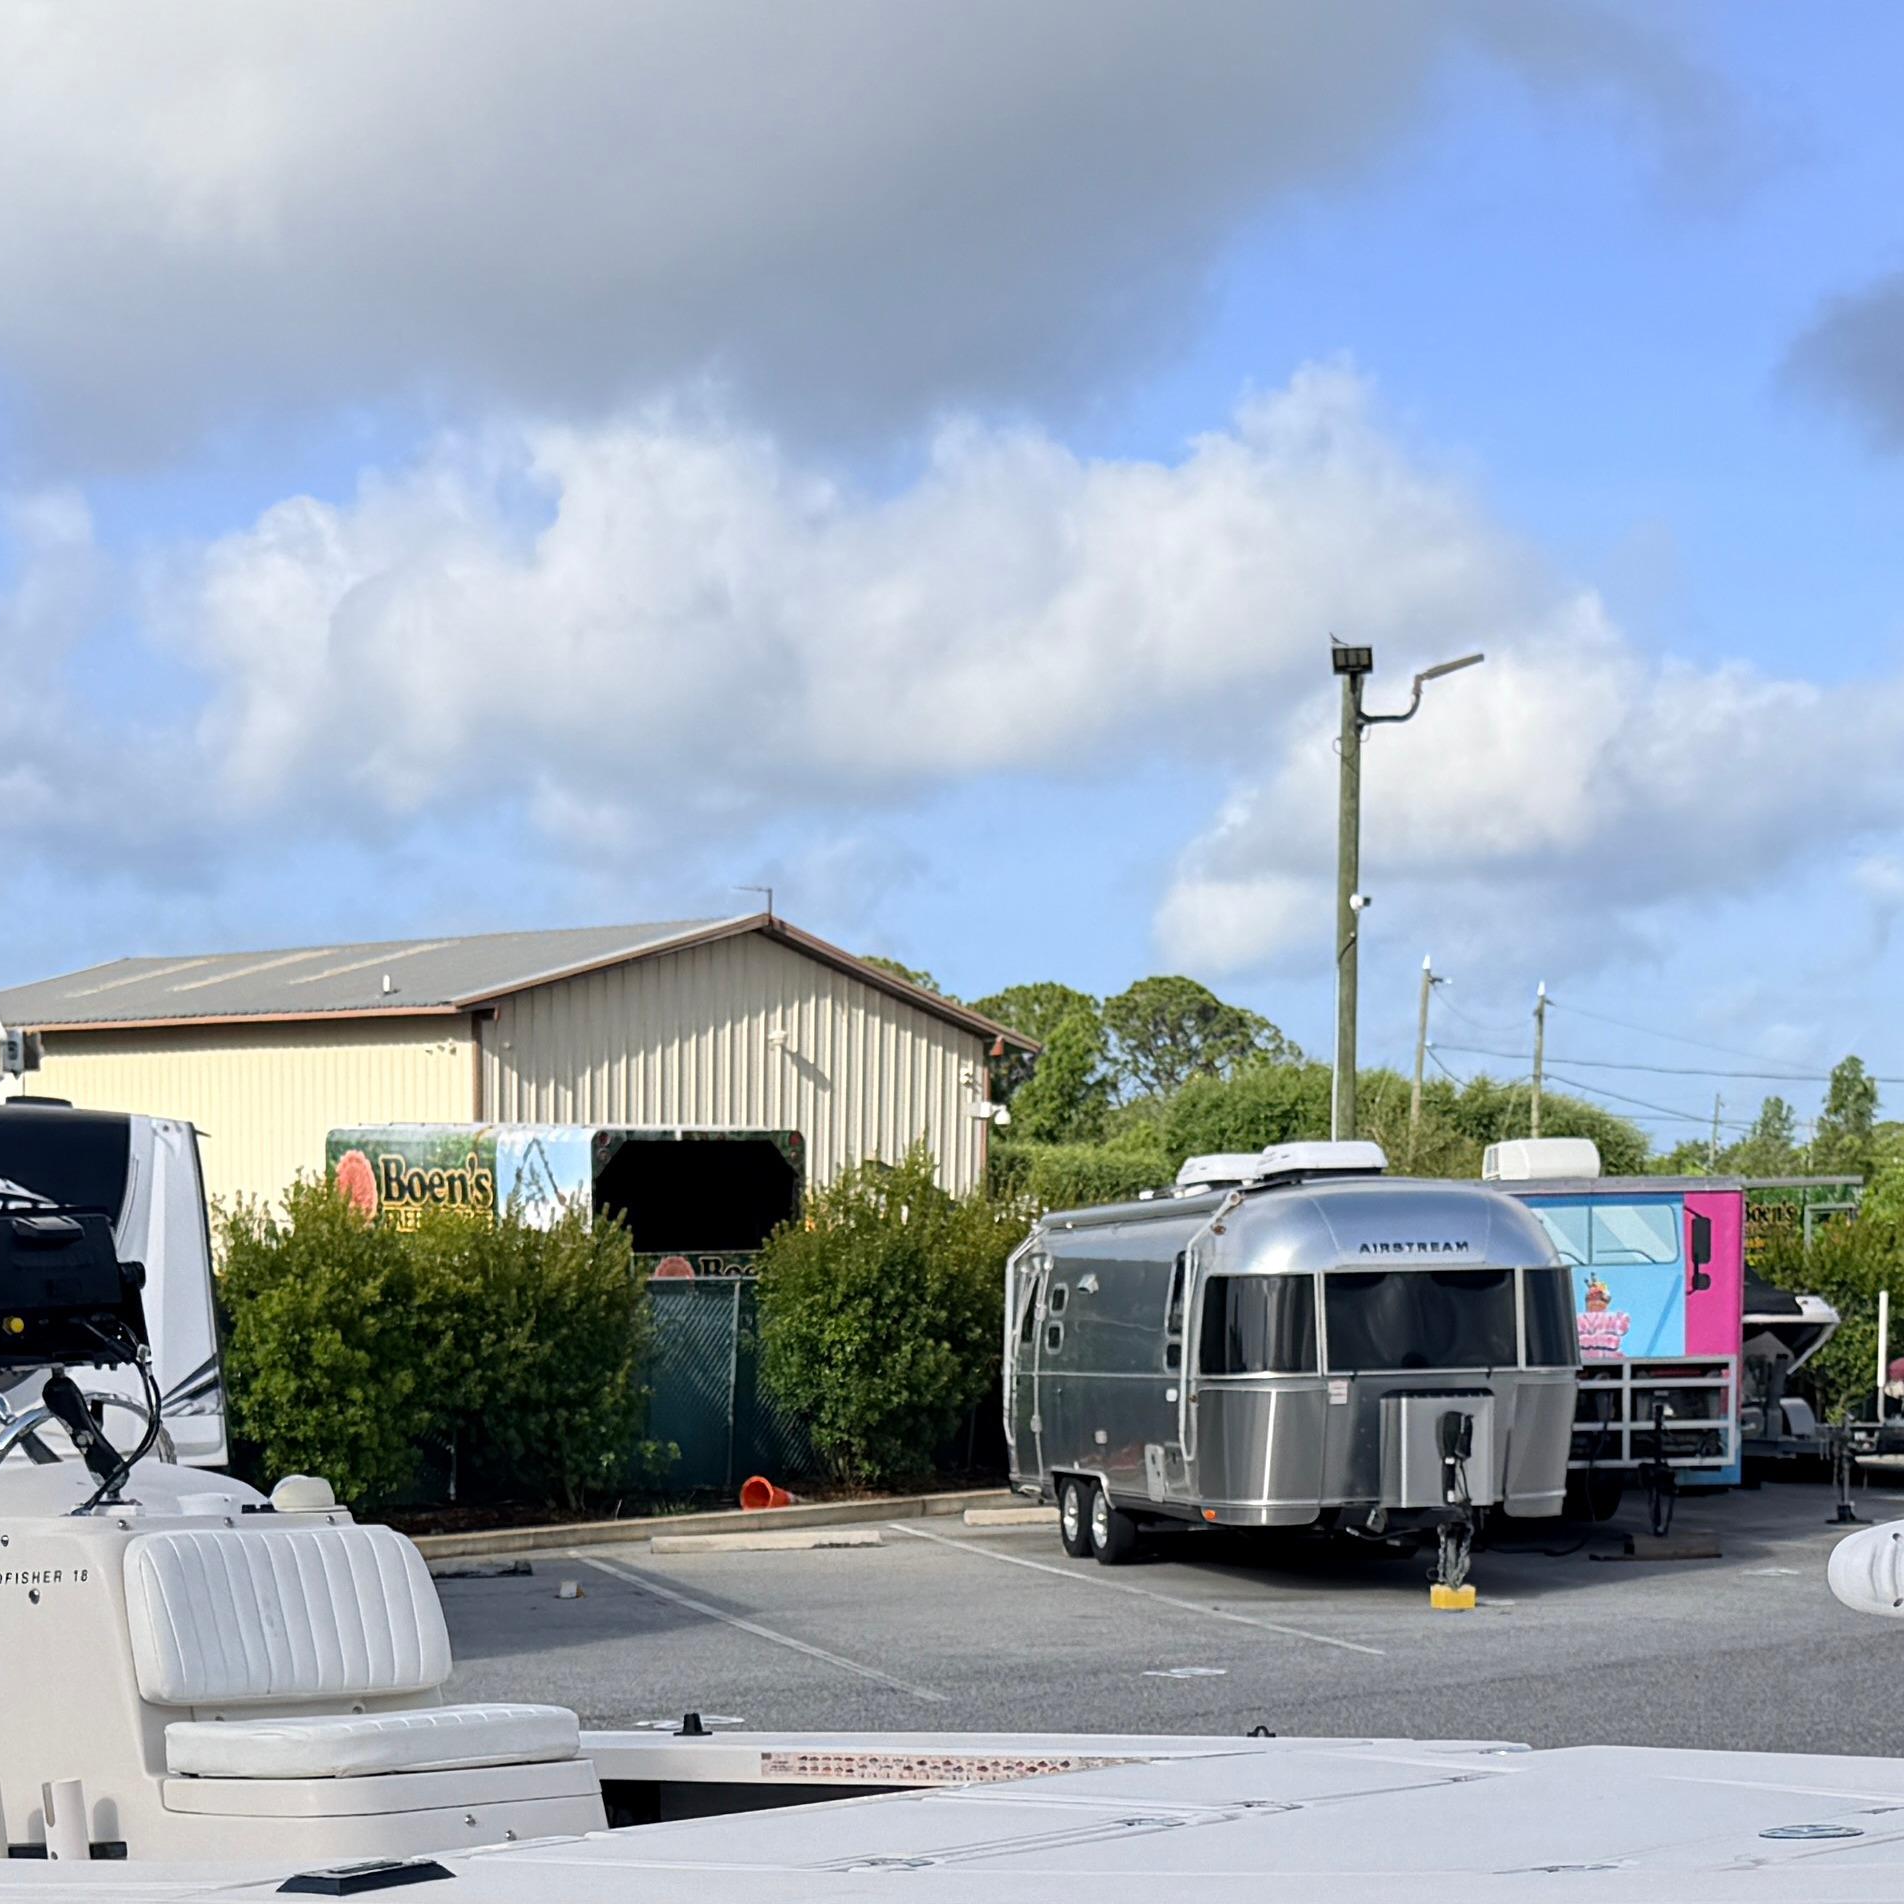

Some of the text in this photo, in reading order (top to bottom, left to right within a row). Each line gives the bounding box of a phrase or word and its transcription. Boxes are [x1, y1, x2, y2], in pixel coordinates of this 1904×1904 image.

[378, 1152, 494, 1208] Boen's
[1359, 1241, 1470, 1254] AIRSTREAM
[73, 1569, 89, 1582] 18
